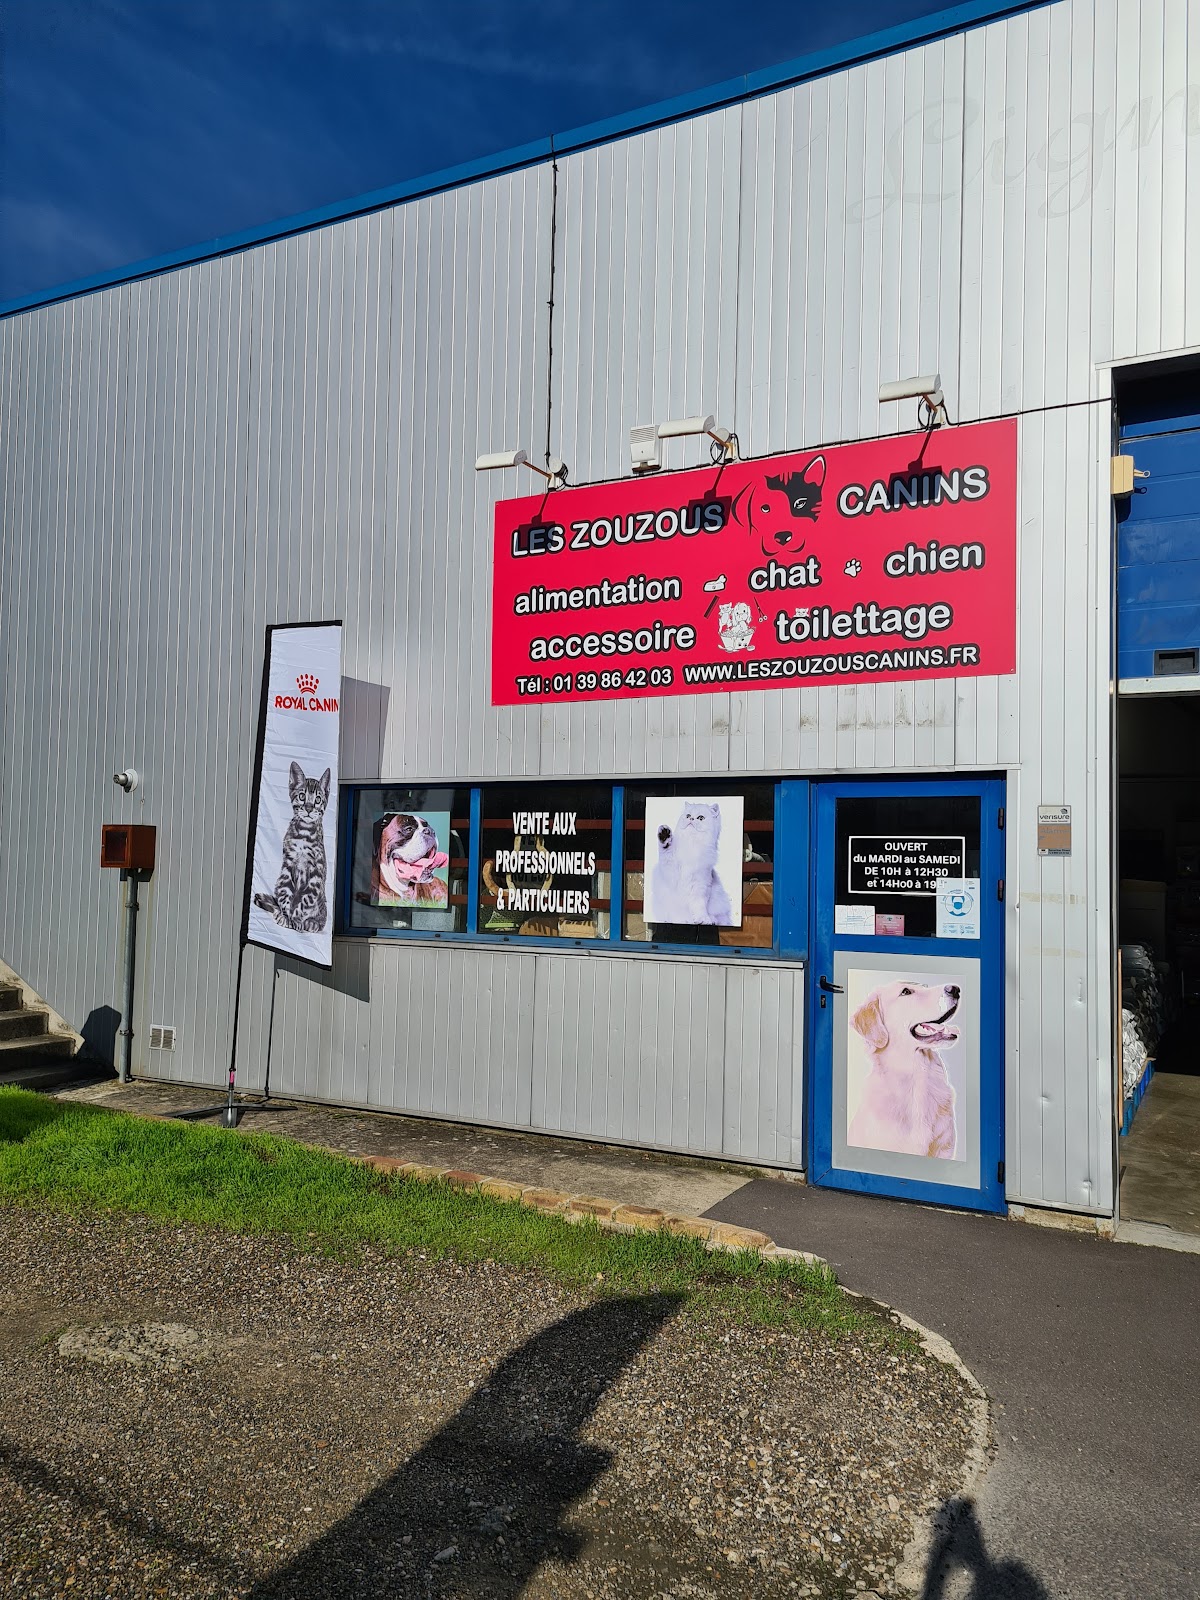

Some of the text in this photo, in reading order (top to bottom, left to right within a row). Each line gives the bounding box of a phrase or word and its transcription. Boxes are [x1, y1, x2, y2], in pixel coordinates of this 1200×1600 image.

[512, 466, 989, 557] LES ZOUZOUS CANINS
[749, 542, 983, 591] chat chien
[514, 575, 681, 615] alimentation
[529, 621, 696, 661] accessoire
[553, 674, 572, 692] 01
[576, 672, 597, 690] 39
[600, 671, 622, 689] 86
[625, 669, 647, 687] 42
[650, 667, 673, 686] 03
[684, 645, 978, 682] WWW.LESZOUZOUSCANINS.FR
[274, 695, 308, 711] ROYAL
[512, 811, 577, 836] VENTE AUX
[853, 853, 961, 865] du MARDI au SAMEDI
[884, 842, 929, 852] OUVERT
[495, 849, 596, 876] PROFESSIONNELS
[864, 866, 949, 877] DE 10H à 12H30
[866, 879, 878, 888] et
[914, 880, 922, 889] à
[496, 887, 590, 915] & PARTICULIERS
